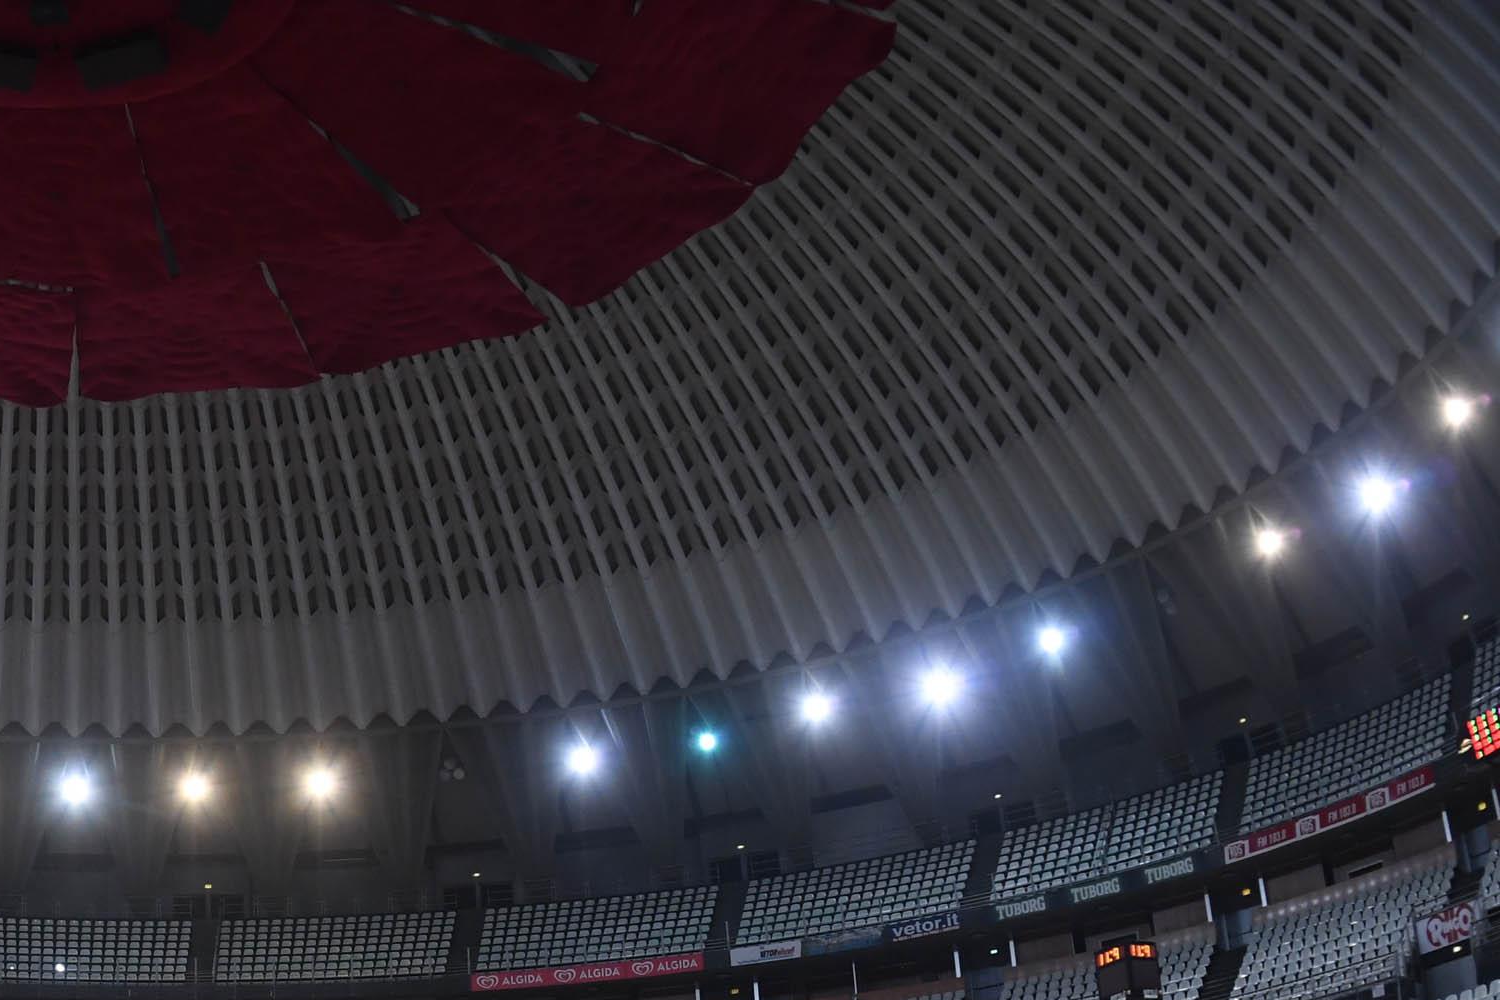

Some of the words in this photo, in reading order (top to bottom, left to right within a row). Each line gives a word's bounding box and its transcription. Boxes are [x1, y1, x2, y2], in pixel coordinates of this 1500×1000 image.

[1144, 857, 1194, 884] TUBORG
[1070, 877, 1121, 903] TUBORG
[996, 896, 1046, 921] TUBORG
[892, 913, 960, 937] vetor.it
[580, 967, 620, 980] ALGIDA
[657, 959, 698, 972] ALGIDA
[502, 974, 543, 986] ALGIDA
